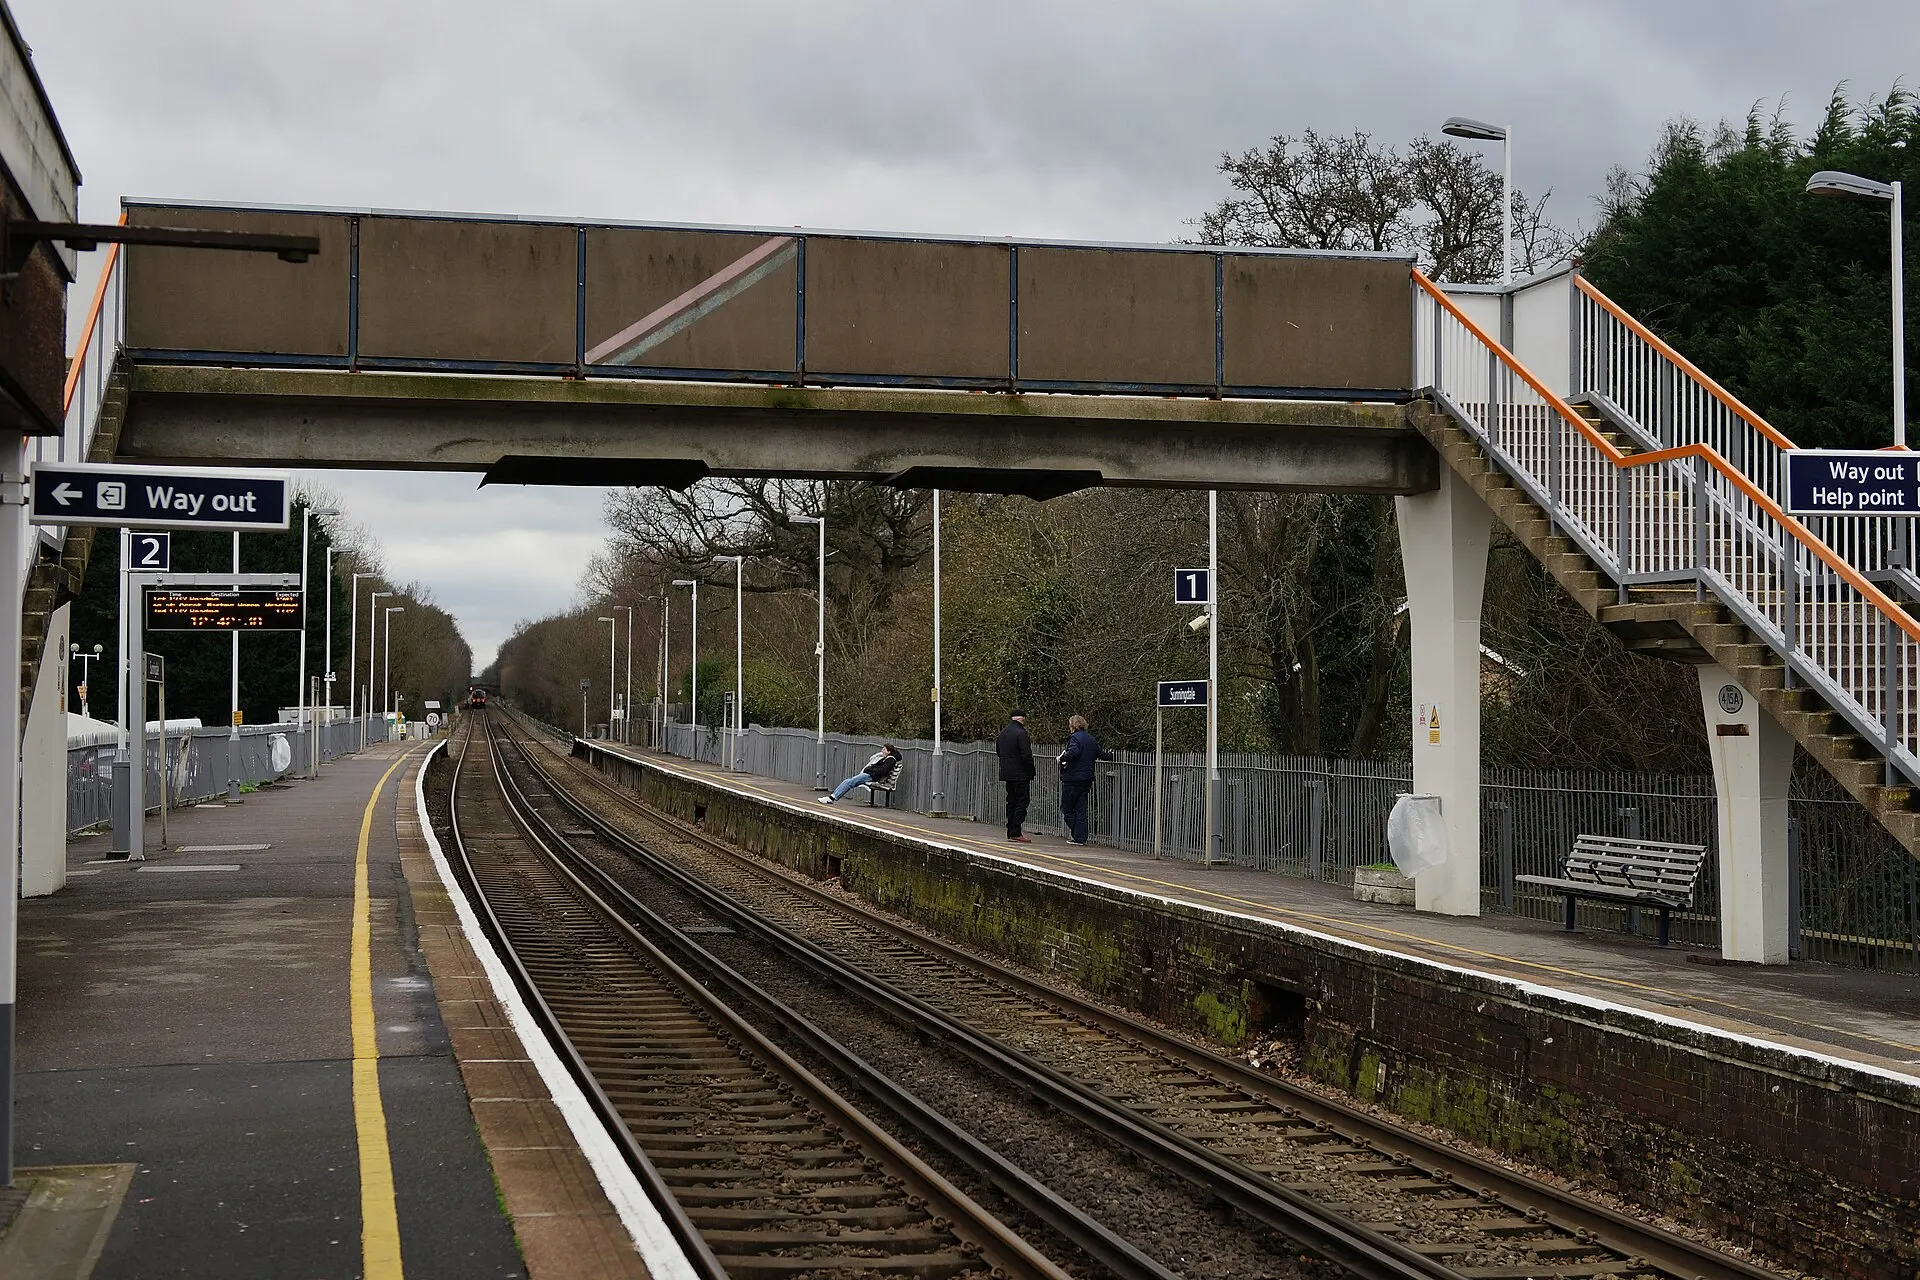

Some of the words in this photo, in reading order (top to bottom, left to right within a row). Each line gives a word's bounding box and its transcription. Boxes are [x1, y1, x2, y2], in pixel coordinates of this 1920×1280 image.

[1829, 461, 1869, 484] Way
[1874, 464, 1905, 480] out
[145, 485, 205, 516] Way
[211, 490, 257, 513] out
[1812, 486, 1854, 509] Help
[1858, 488, 1905, 509] point
[141, 537, 160, 565] 2
[1186, 574, 1196, 598] 1
[1170, 687, 1195, 703] Sunningdale
